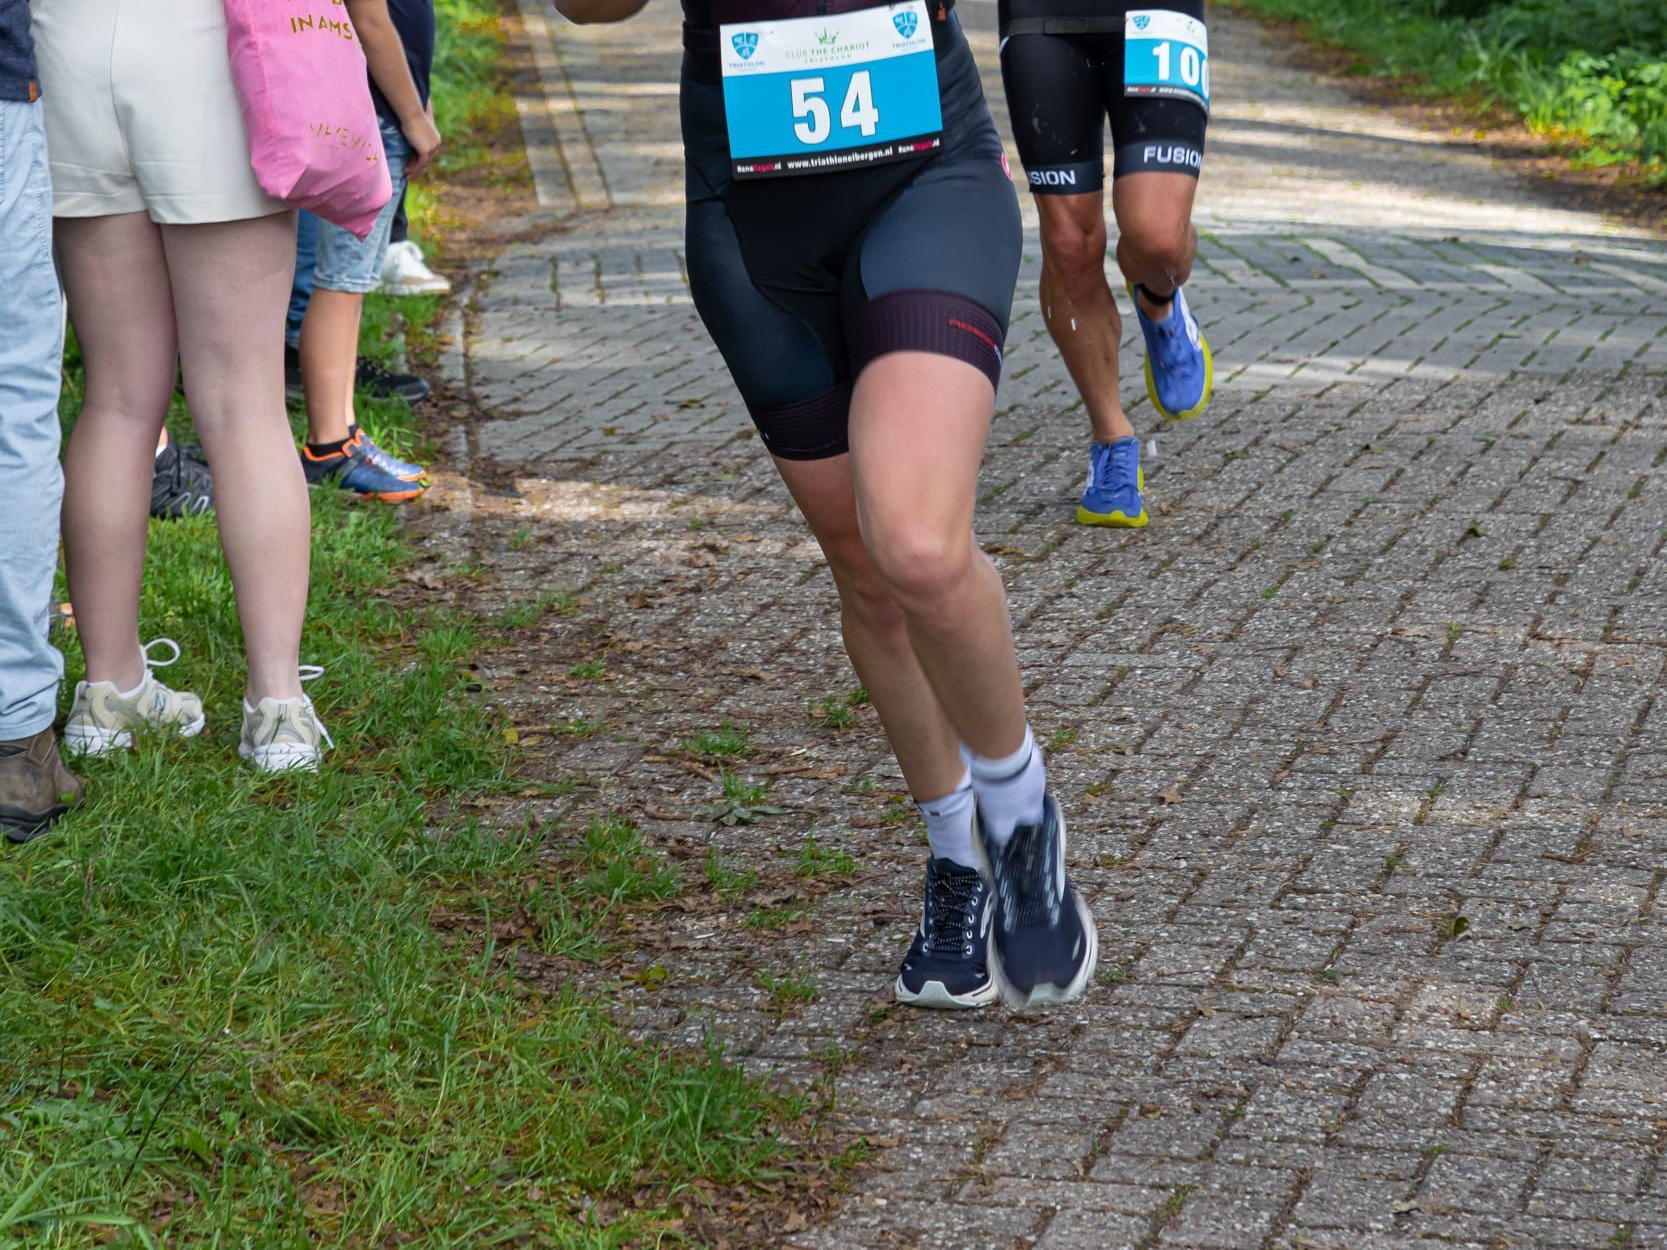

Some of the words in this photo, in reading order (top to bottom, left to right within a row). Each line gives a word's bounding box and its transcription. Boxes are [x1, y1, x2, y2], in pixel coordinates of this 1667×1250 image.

[290, 14, 313, 34] IN
[811, 48, 827, 56] THE
[831, 41, 870, 55] CHARIOT
[789, 69, 880, 145] 54
